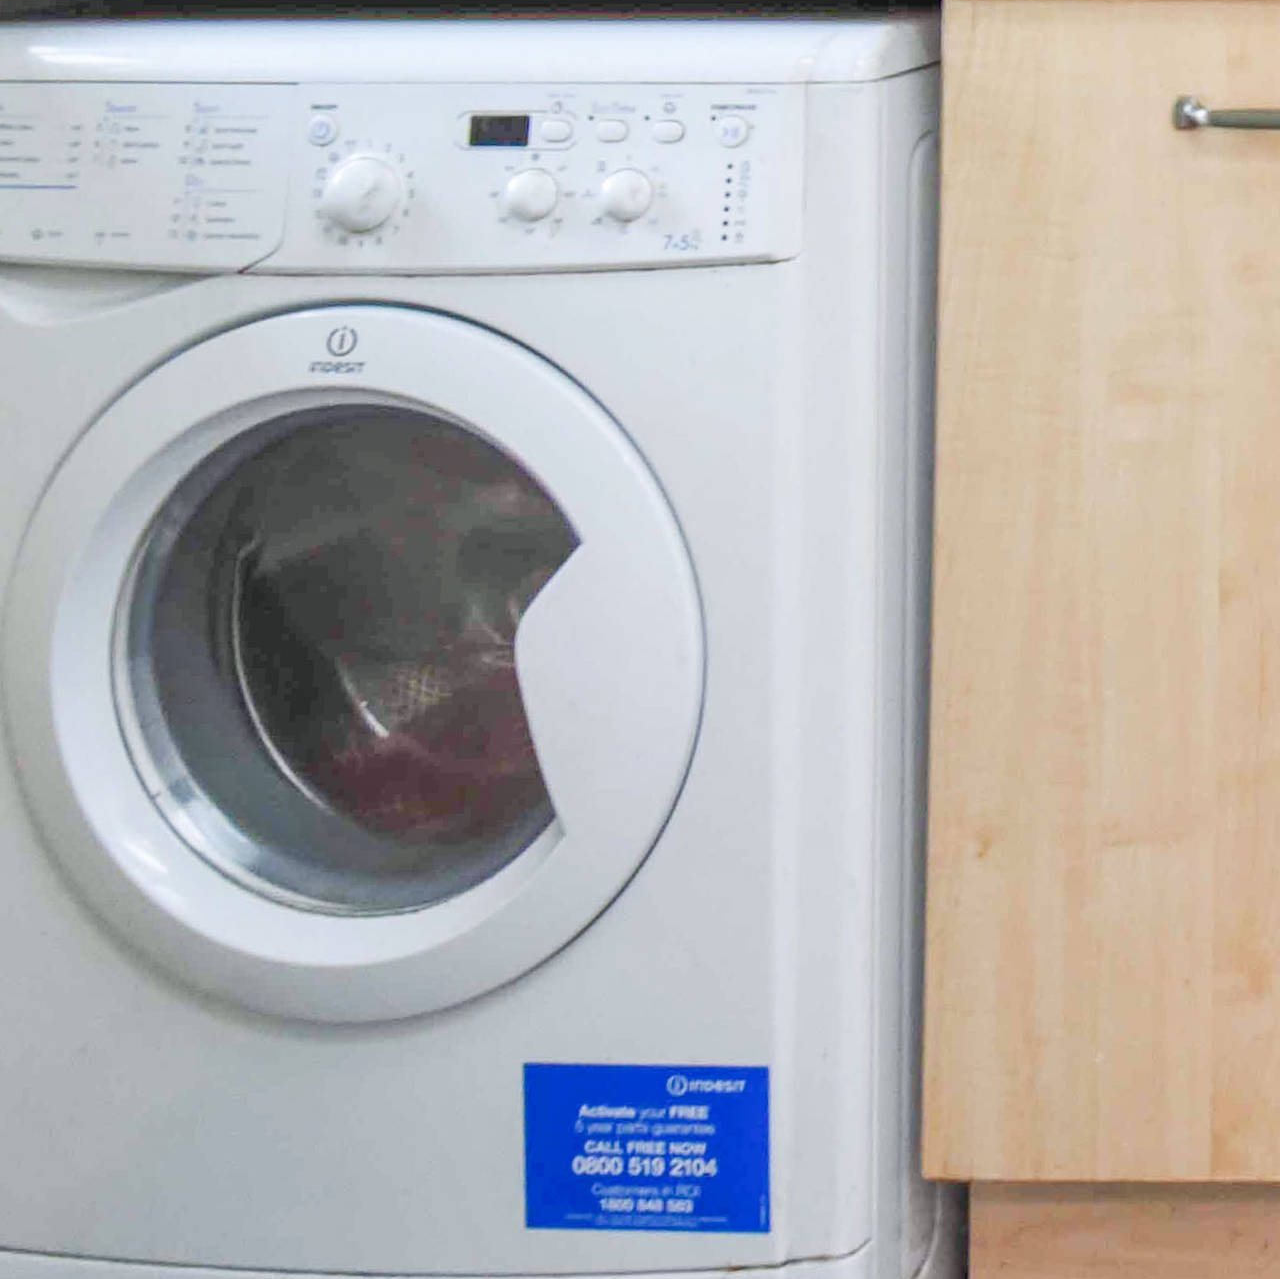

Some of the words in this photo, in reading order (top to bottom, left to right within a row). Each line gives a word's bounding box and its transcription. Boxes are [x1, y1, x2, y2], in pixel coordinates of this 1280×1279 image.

[578, 1104, 636, 1118] Activate
[668, 1105, 709, 1120] FREE
[584, 1139, 624, 1154] CALL
[626, 1140, 666, 1155] FREE
[668, 1142, 707, 1155] NOW
[572, 1155, 624, 1176] 0800
[627, 1156, 666, 1177] 519
[668, 1158, 718, 1178] 2104
